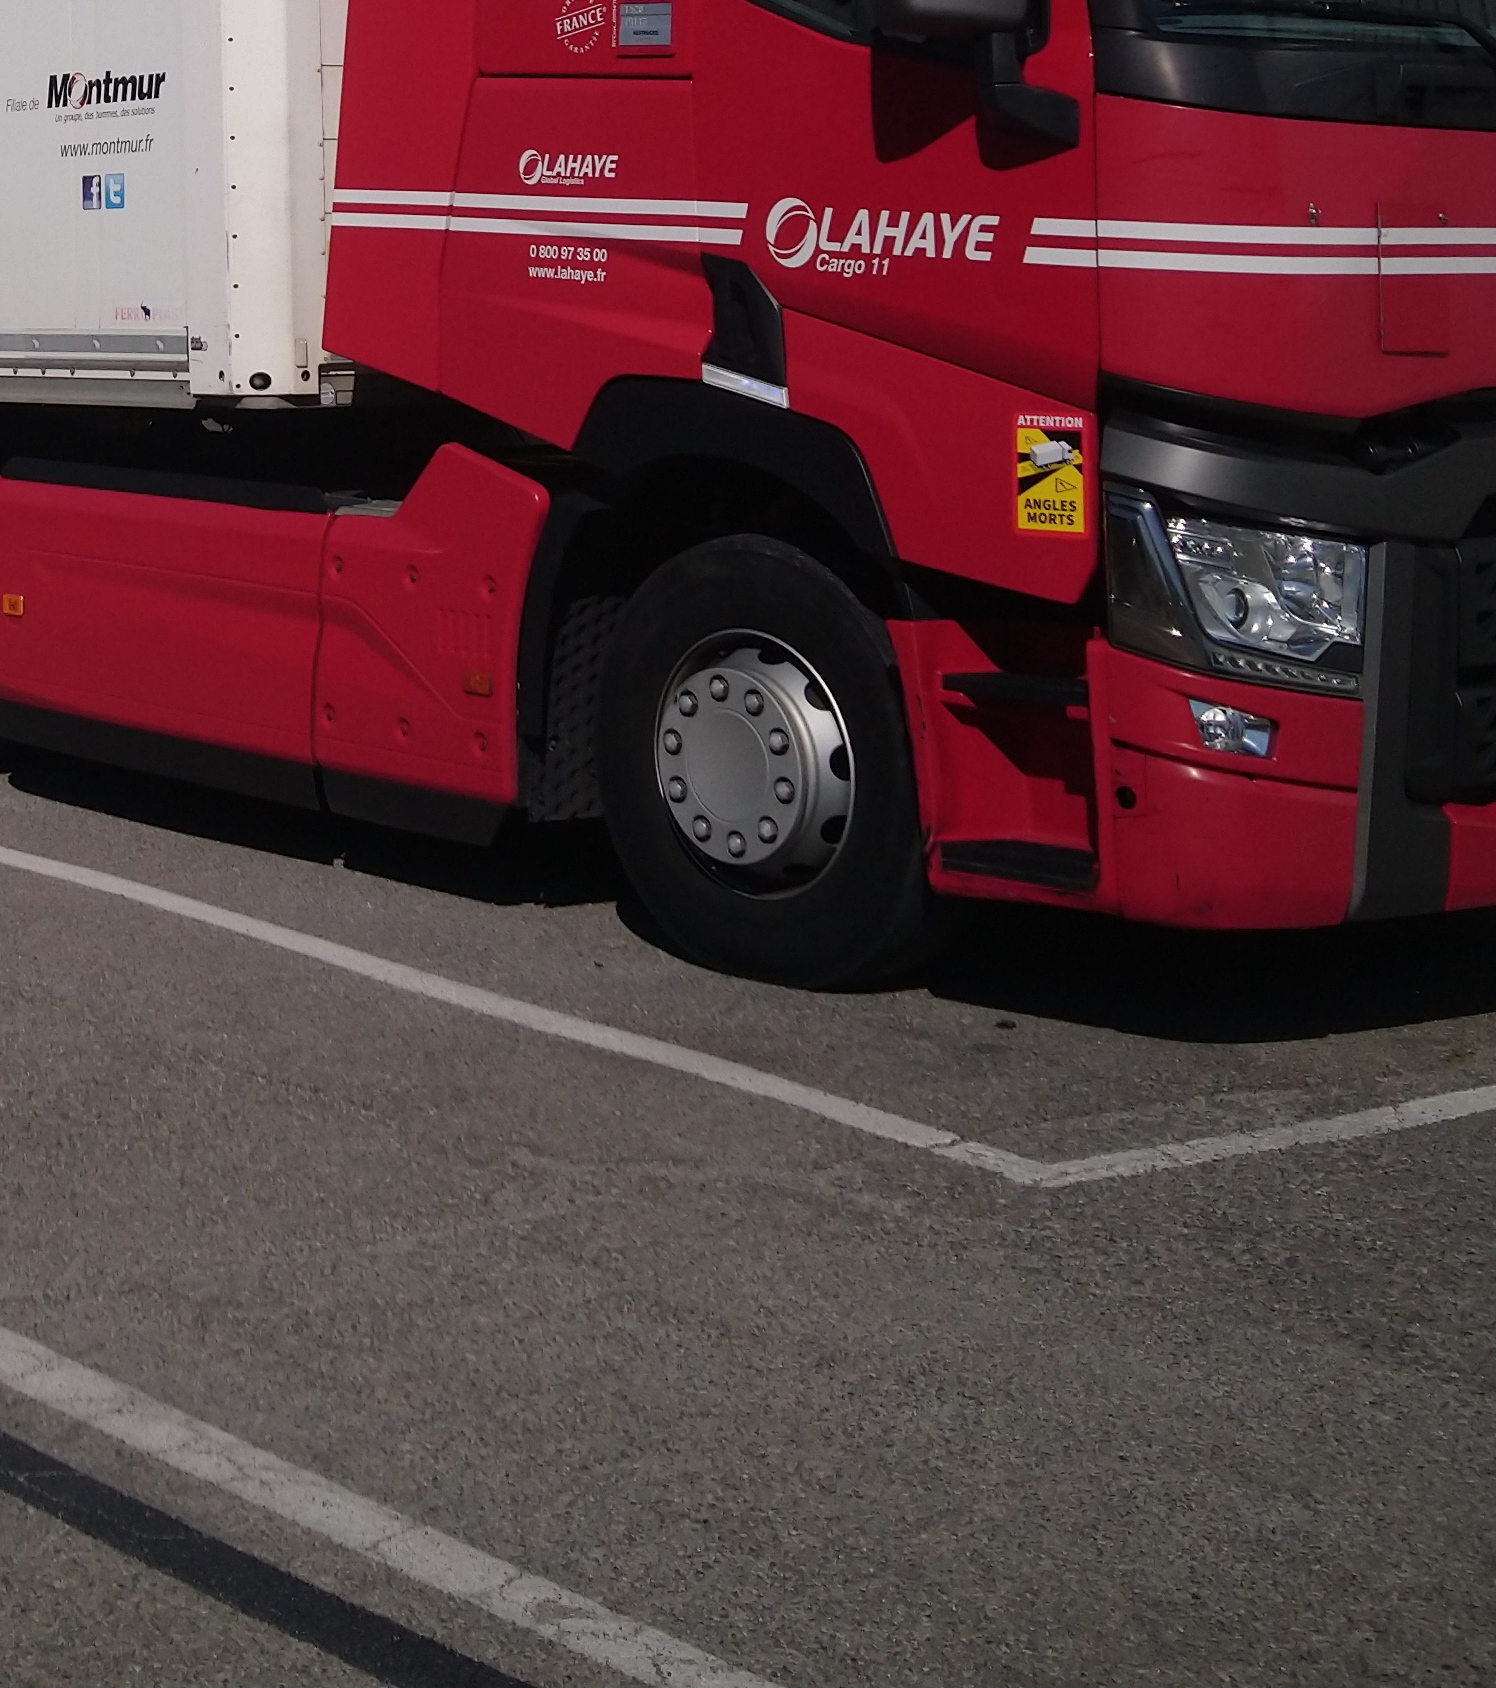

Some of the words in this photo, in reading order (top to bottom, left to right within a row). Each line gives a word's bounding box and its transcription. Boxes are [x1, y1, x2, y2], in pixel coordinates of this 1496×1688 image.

[556, 6, 604, 34] FRANCE
[564, 30, 599, 54] GARANTIE
[47, 71, 166, 109] Montmur
[5, 99, 27, 112] Filiale
[28, 97, 40, 110] de
[60, 134, 154, 157] www.montmur.fr
[542, 154, 619, 178] LAHAYE
[817, 207, 1000, 262] LAHAYE
[529, 244, 537, 257] 0
[539, 245, 559, 260] 800
[560, 246, 575, 260] 97
[576, 247, 591, 261] 35
[593, 248, 608, 262] 00
[528, 265, 607, 285] www.lahaye.fr
[815, 253, 865, 278] Cargo
[871, 257, 890, 276] 11
[1017, 415, 1083, 428] ATTENTION
[1024, 498, 1077, 512] ANGLES
[1027, 512, 1075, 526] MORTS
